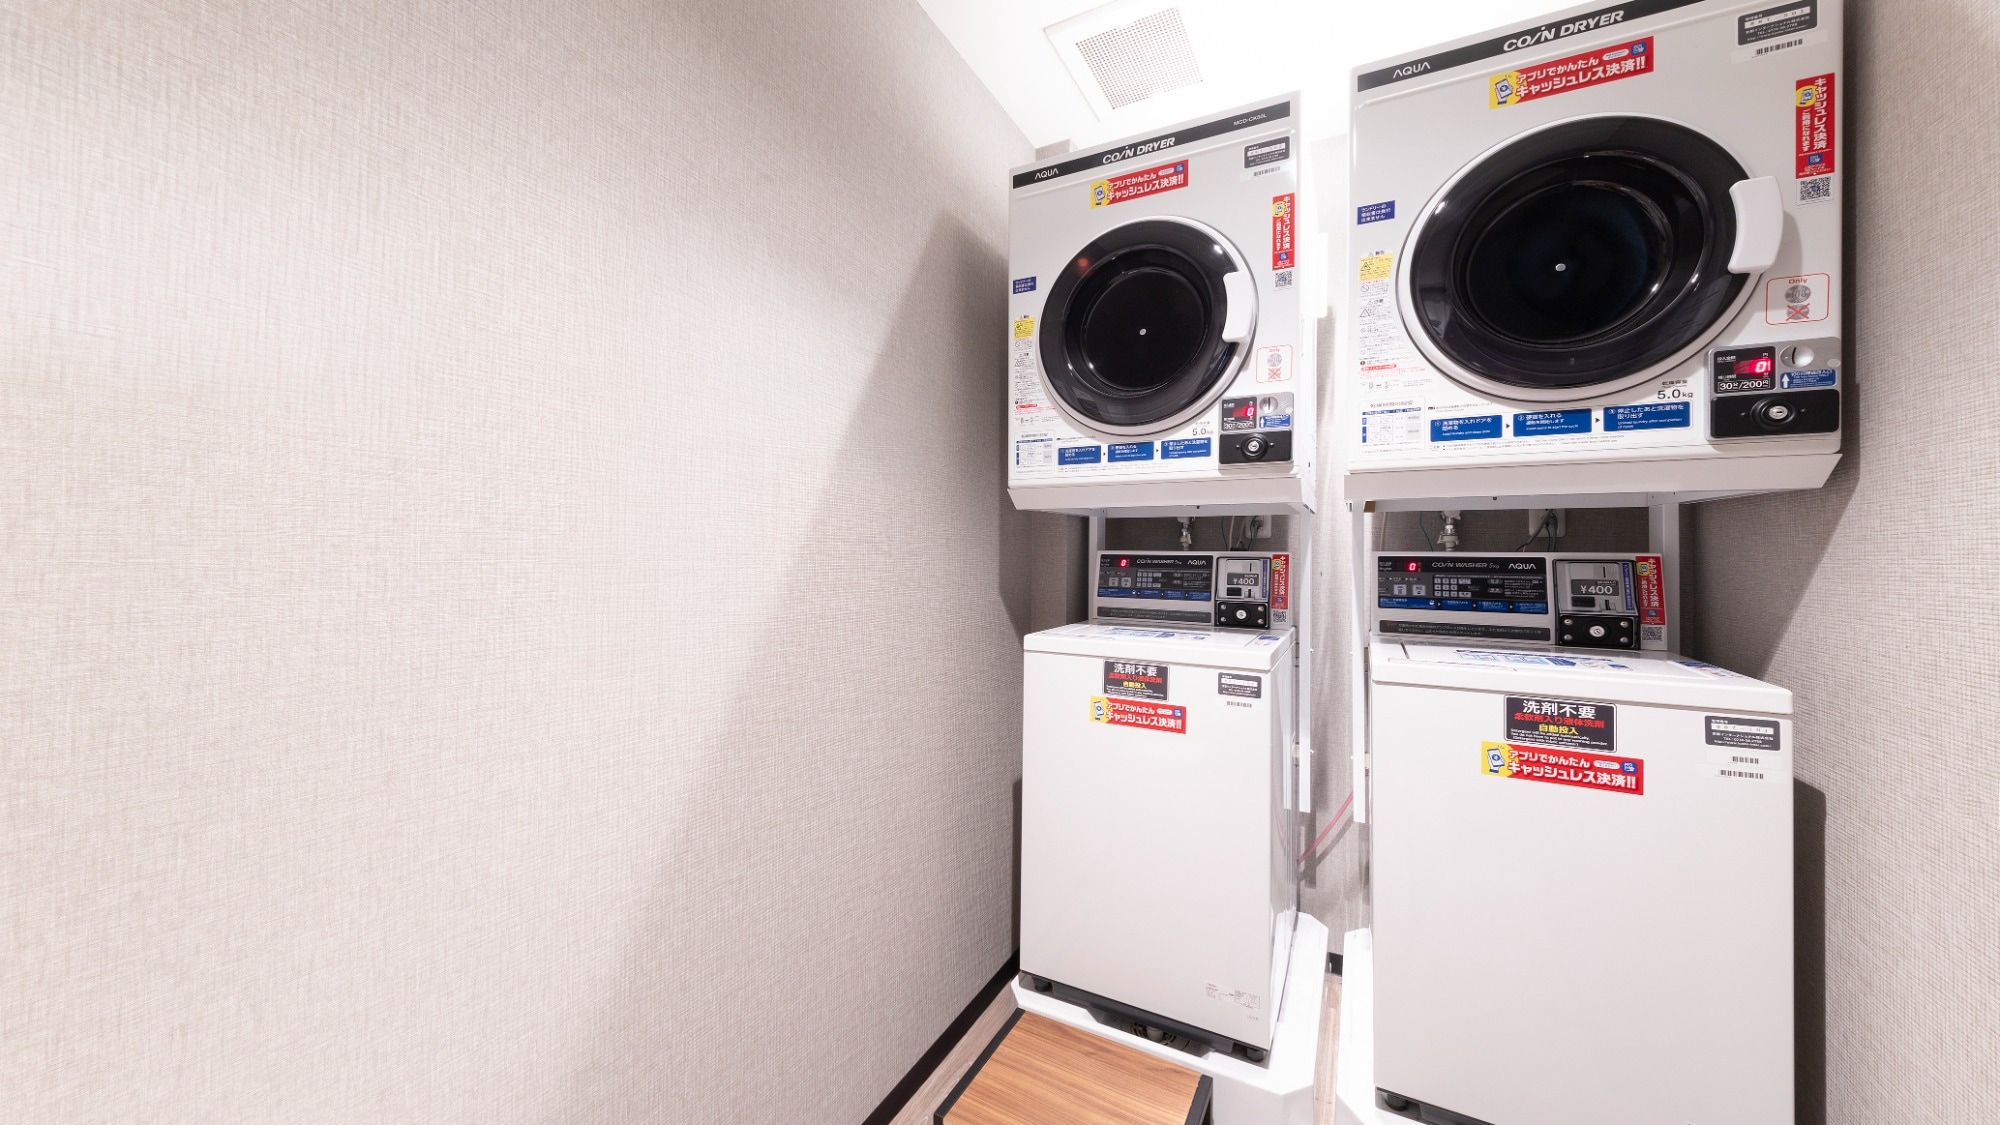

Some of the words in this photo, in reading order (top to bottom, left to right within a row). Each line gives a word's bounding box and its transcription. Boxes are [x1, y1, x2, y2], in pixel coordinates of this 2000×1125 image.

[1560, 10, 1624, 37] DRYER
[1393, 62, 1430, 79] AQUA
[1517, 57, 1599, 84] アプリでかんたん
[1814, 78, 1827, 150] キャッシュレス決済
[1136, 137, 1175, 156] DRYER
[1034, 168, 1058, 180] AQUA
[1108, 173, 1156, 189] アプリでかんたん
[1580, 585, 1613, 594] ¥400
[1107, 703, 1155, 714] アプリでかんたん
[1523, 700, 1596, 719] 洗剤不要
[1539, 724, 1578, 735] 自動投入
[1508, 750, 1590, 768] アプリでかんたん
